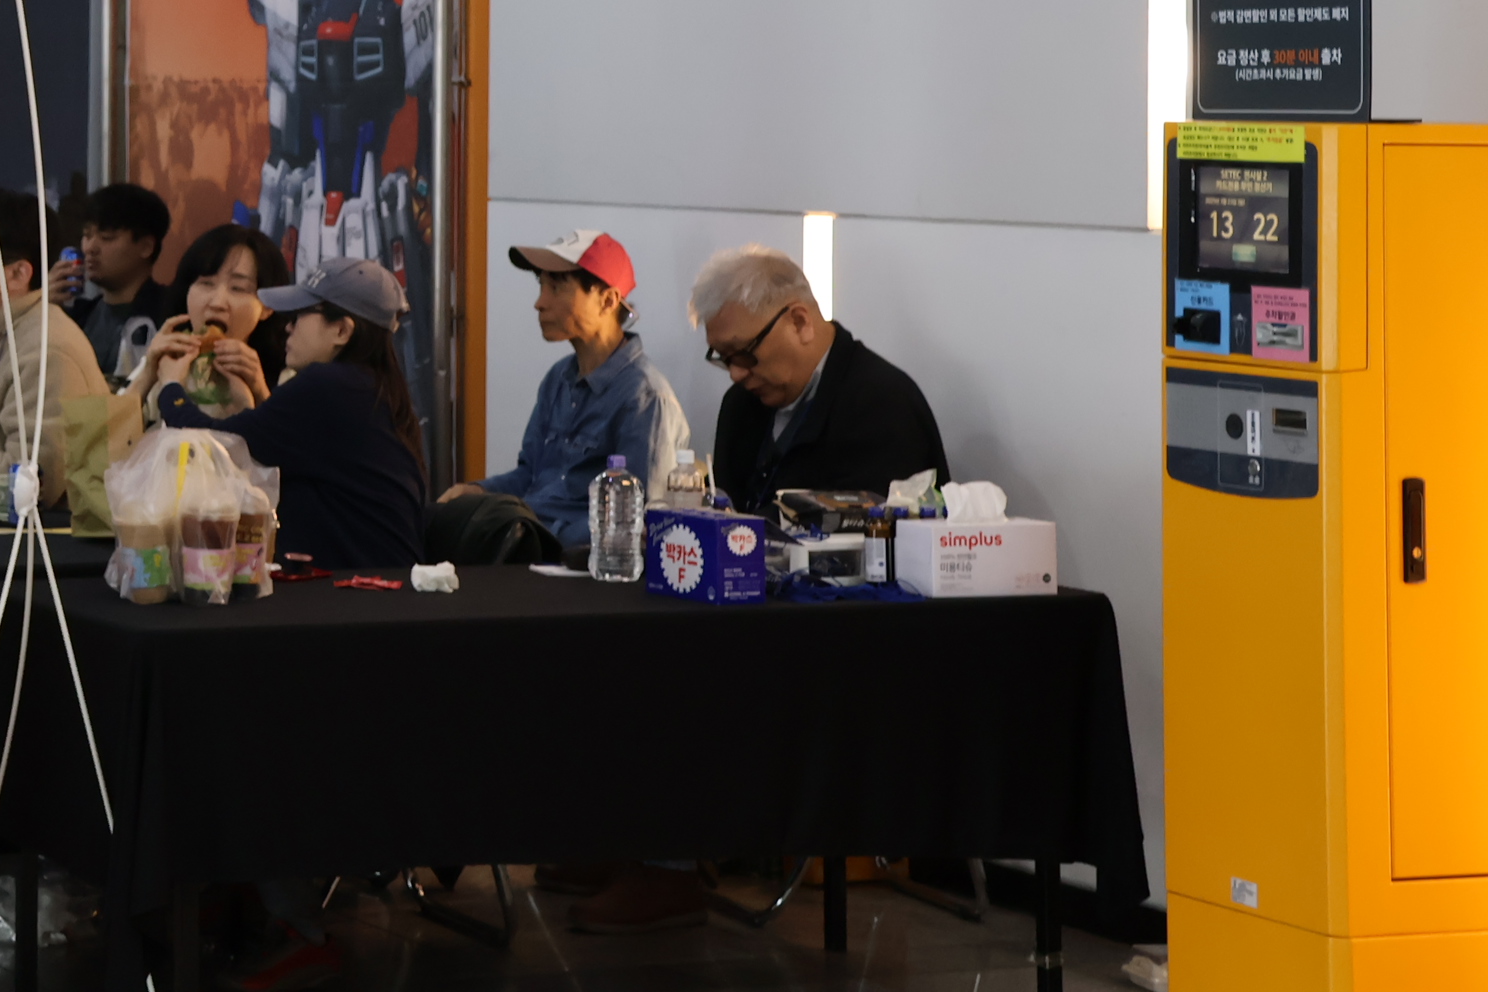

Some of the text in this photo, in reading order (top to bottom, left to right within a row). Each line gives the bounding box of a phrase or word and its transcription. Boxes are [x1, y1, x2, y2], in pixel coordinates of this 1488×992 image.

[1217, 49, 1237, 66] 요금
[1239, 49, 1258, 66] 정산
[1261, 49, 1271, 66] 후
[1299, 48, 1320, 65] 이내
[1210, 210, 1279, 242] 13 22
[940, 531, 1002, 550] simplus
[665, 543, 698, 566] 박카스
[678, 567, 687, 583] F
